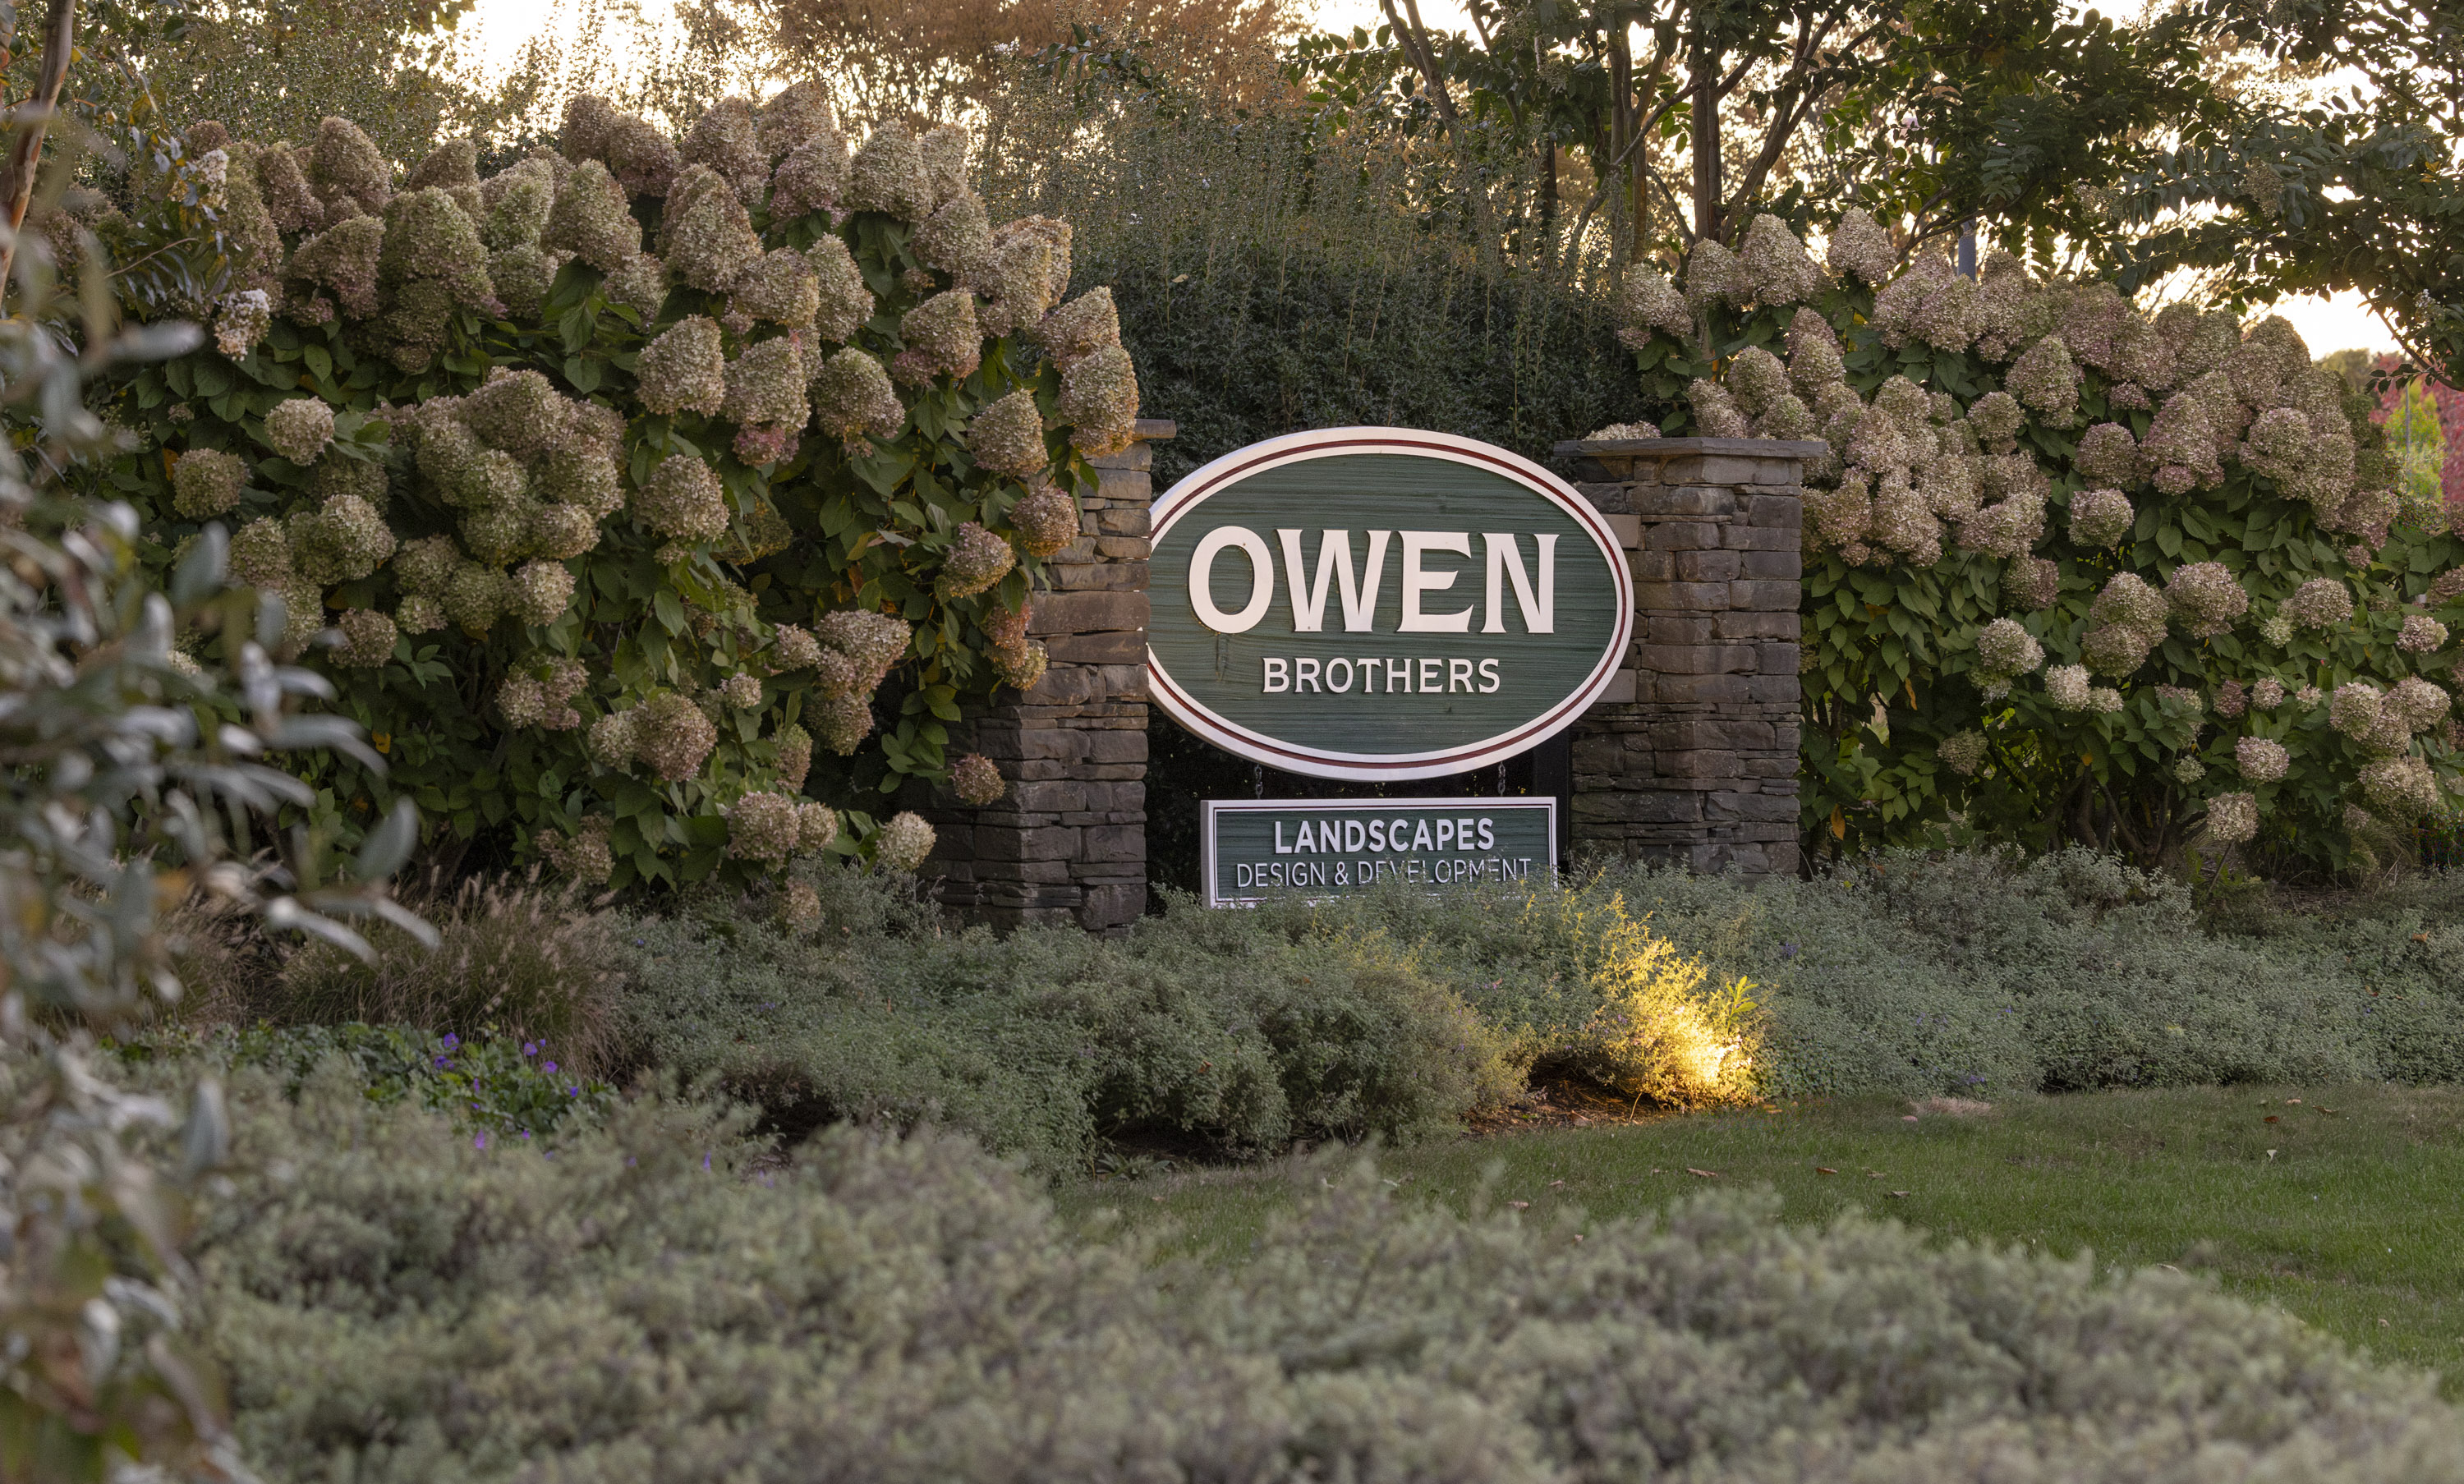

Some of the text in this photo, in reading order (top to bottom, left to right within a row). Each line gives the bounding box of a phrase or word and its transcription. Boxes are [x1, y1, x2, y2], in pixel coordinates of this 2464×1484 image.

[1188, 526, 1560, 634] OWEN
[1262, 657, 1501, 693] BROTHERS
[1275, 818, 1495, 854] LANDSCAPES
[1237, 861, 1326, 888] DESIGN
[1334, 861, 1349, 886] &
